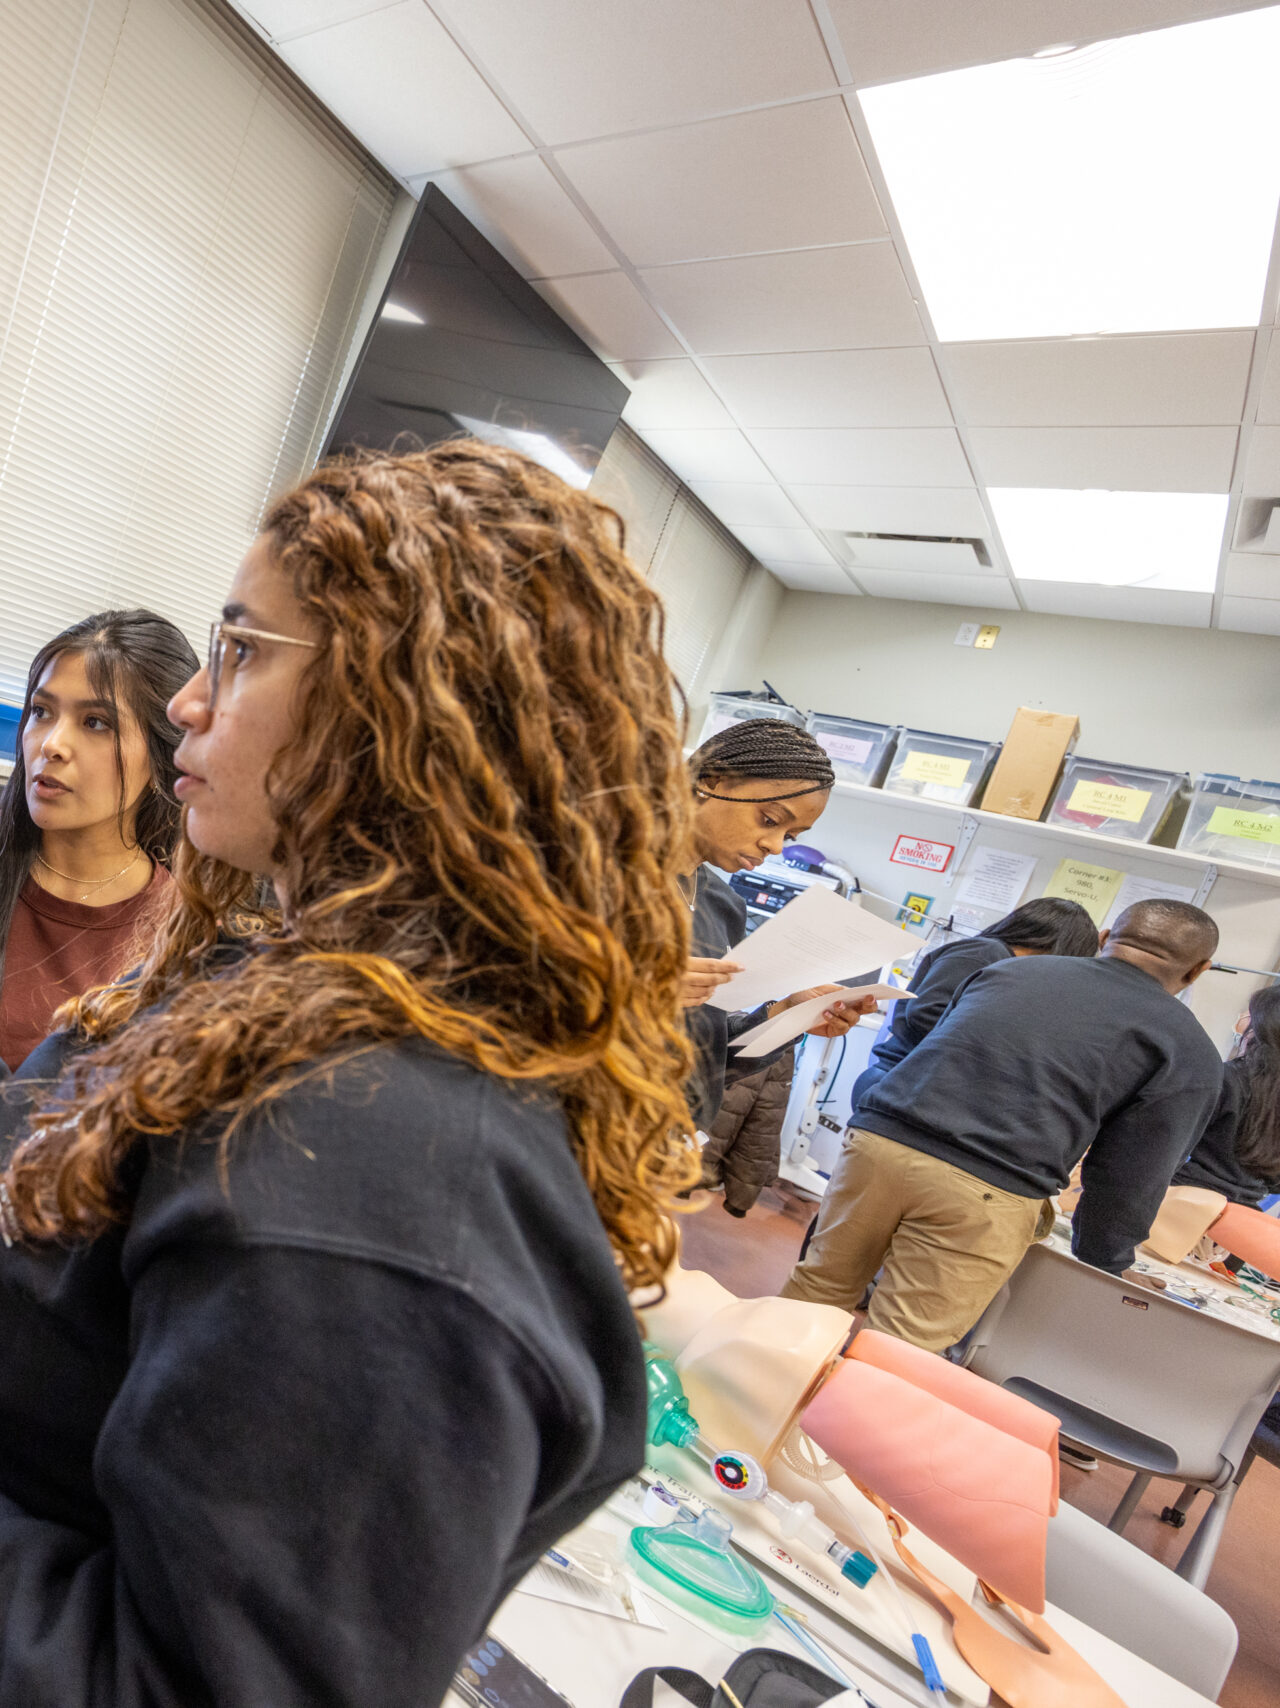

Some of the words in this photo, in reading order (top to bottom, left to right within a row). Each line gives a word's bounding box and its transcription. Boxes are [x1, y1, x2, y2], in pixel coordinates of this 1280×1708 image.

[898, 847, 943, 863] SMOKING
[1068, 866, 1098, 881] Corner
[795, 1563, 842, 1598] Laerdal
